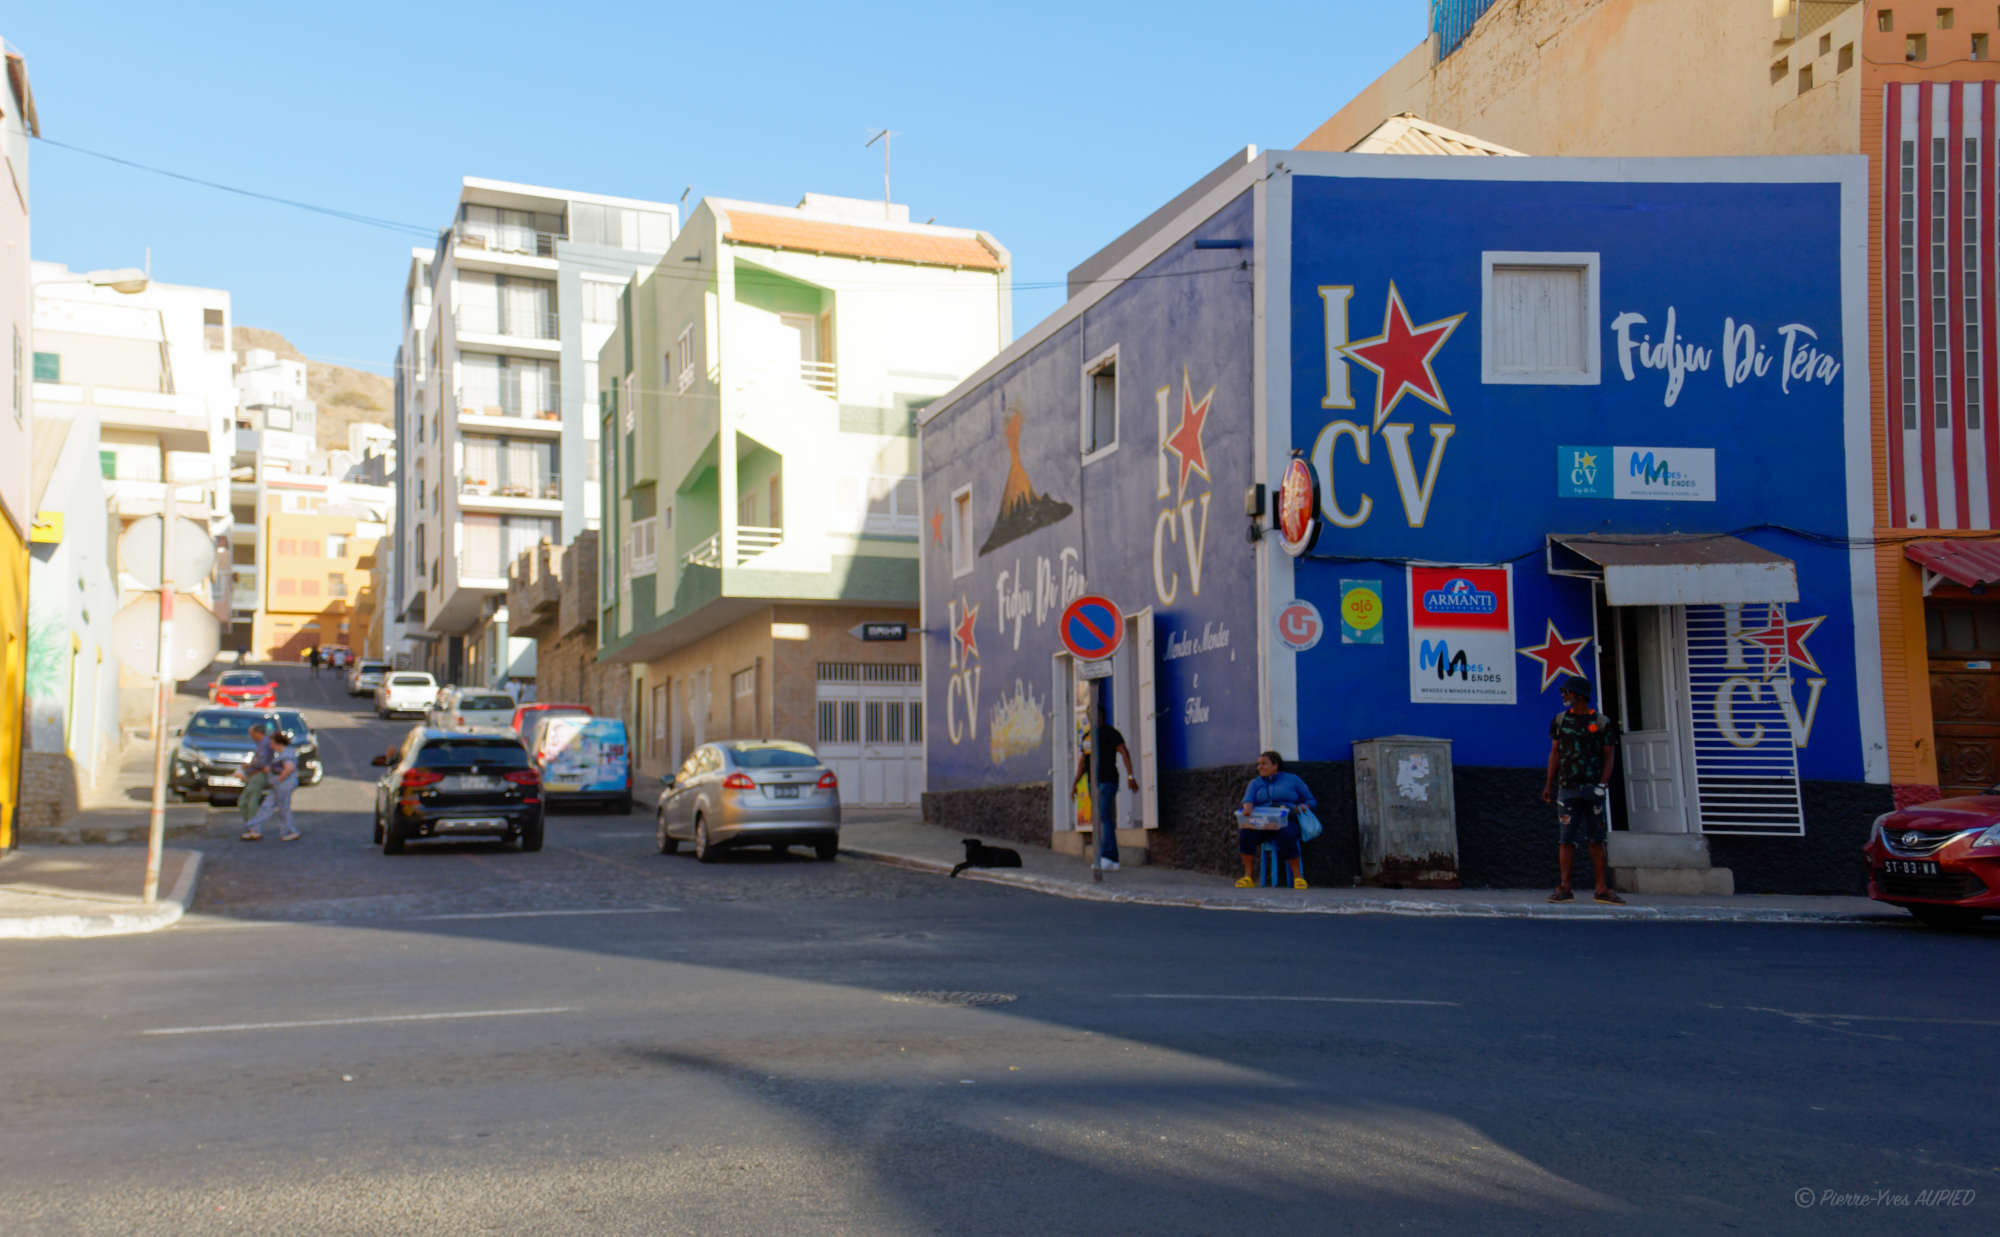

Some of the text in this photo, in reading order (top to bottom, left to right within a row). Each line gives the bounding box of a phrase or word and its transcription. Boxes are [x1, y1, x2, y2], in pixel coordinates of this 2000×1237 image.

[1610, 305, 1841, 408] Fidju Di Téra
[1311, 420, 1457, 529] CV
[1571, 468, 1597, 486] CV
[1153, 490, 1212, 607] CV
[996, 557, 1033, 651] Fidju
[1036, 554, 1058, 628] Di
[1428, 593, 1493, 607] ARMANTI
[947, 665, 982, 746] CV
[1713, 676, 1827, 749] CV
